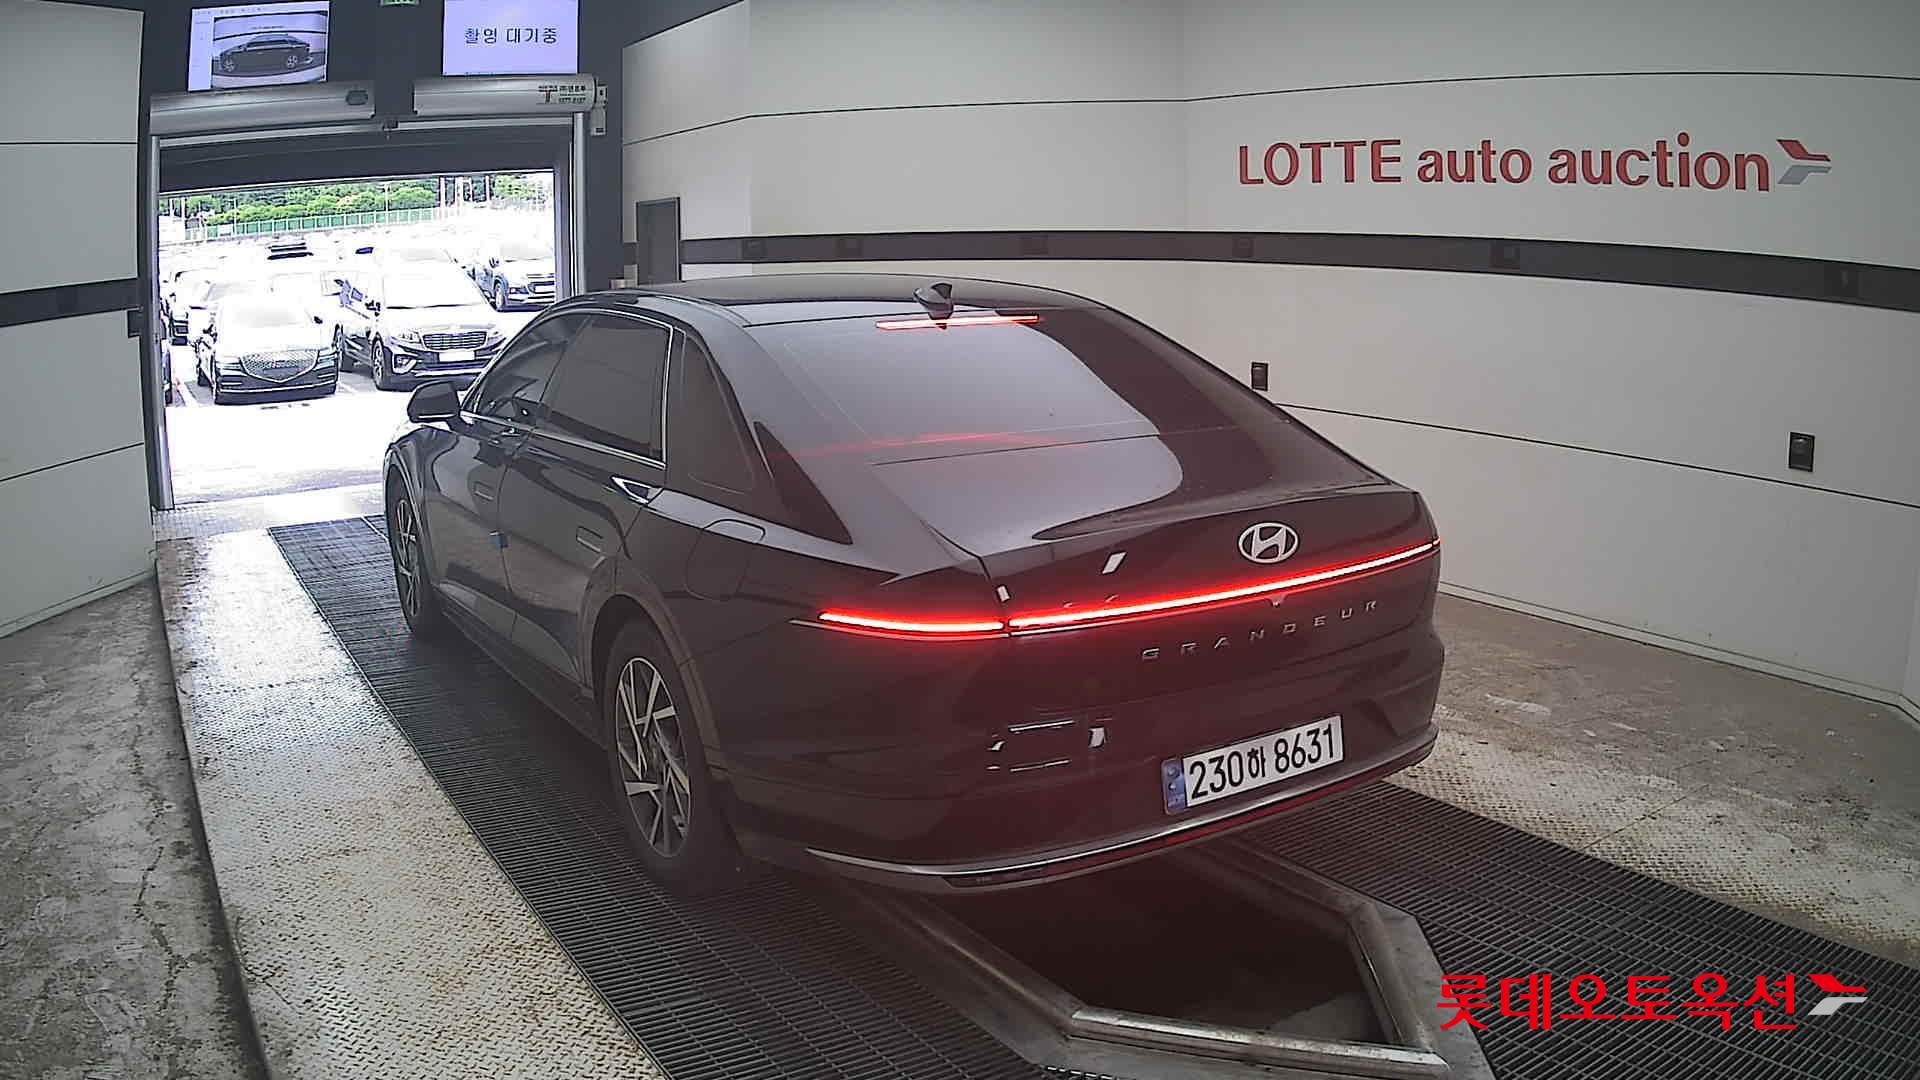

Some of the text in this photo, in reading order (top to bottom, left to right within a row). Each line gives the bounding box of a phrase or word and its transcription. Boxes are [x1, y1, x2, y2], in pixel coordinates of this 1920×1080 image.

[506, 27, 557, 44] 대기중
[1238, 131, 1771, 192] LOTTE auto auction
[1141, 600, 1377, 661] GRANDEUR
[1188, 723, 1334, 800] 230하 8631
